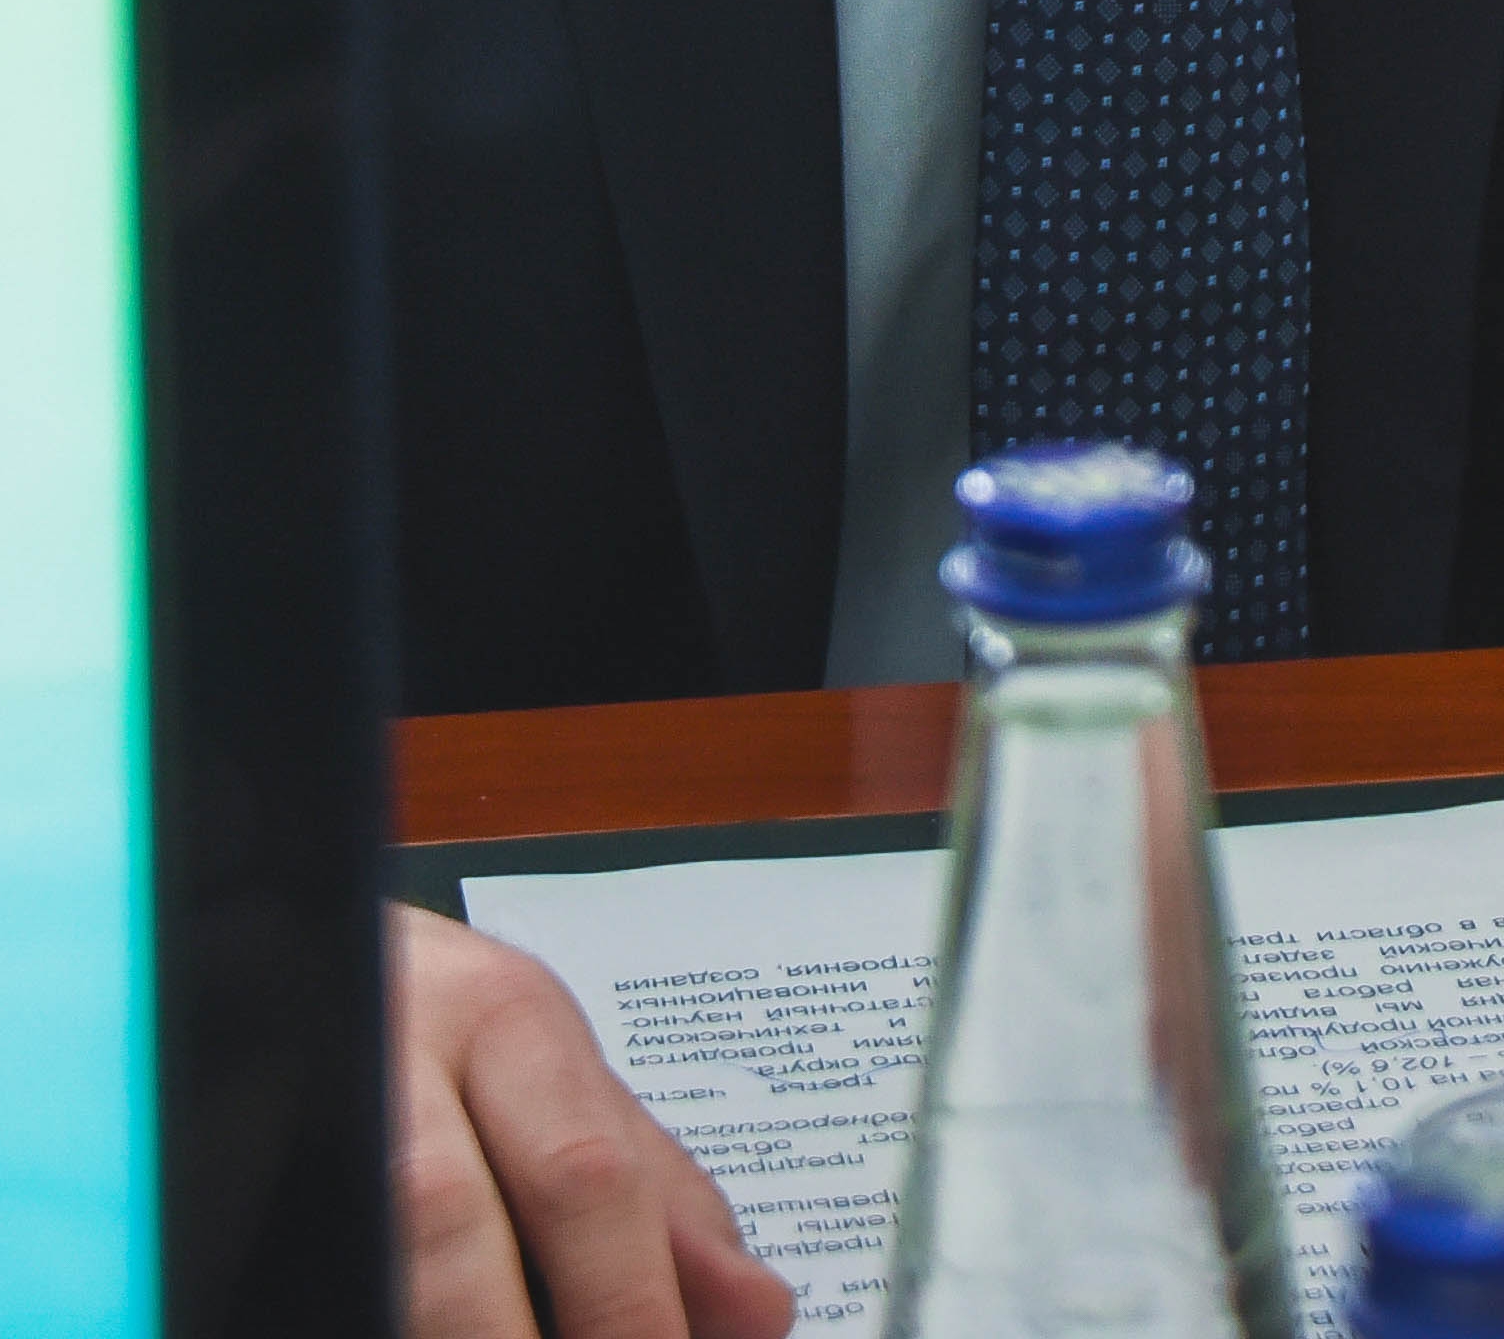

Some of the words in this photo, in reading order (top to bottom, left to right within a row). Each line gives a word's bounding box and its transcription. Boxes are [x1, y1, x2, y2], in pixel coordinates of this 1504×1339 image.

[1316, 923, 1443, 943] области
[1458, 919, 1477, 931] в
[776, 954, 938, 978] строения,
[1232, 965, 1357, 983] произво
[613, 968, 760, 994] создания
[1303, 979, 1413, 1002] работа
[616, 980, 868, 1013] инновационных
[1375, 1000, 1424, 1014] мы
[765, 995, 934, 1020] статочный
[620, 1009, 743, 1030] научно-
[1250, 1019, 1416, 1041] продукции
[625, 1021, 845, 1049] техническому
[628, 1041, 814, 1068] проводится
[1370, 1055, 1452, 1074] 102,6
[770, 1074, 877, 1095] третья
[1310, 1082, 1341, 1096] %
[1356, 1076, 1415, 1094] 10,1
[1430, 1072, 1468, 1085] на
[1268, 1096, 1400, 1117] отрасле
[754, 1235, 883, 1260] предыд
